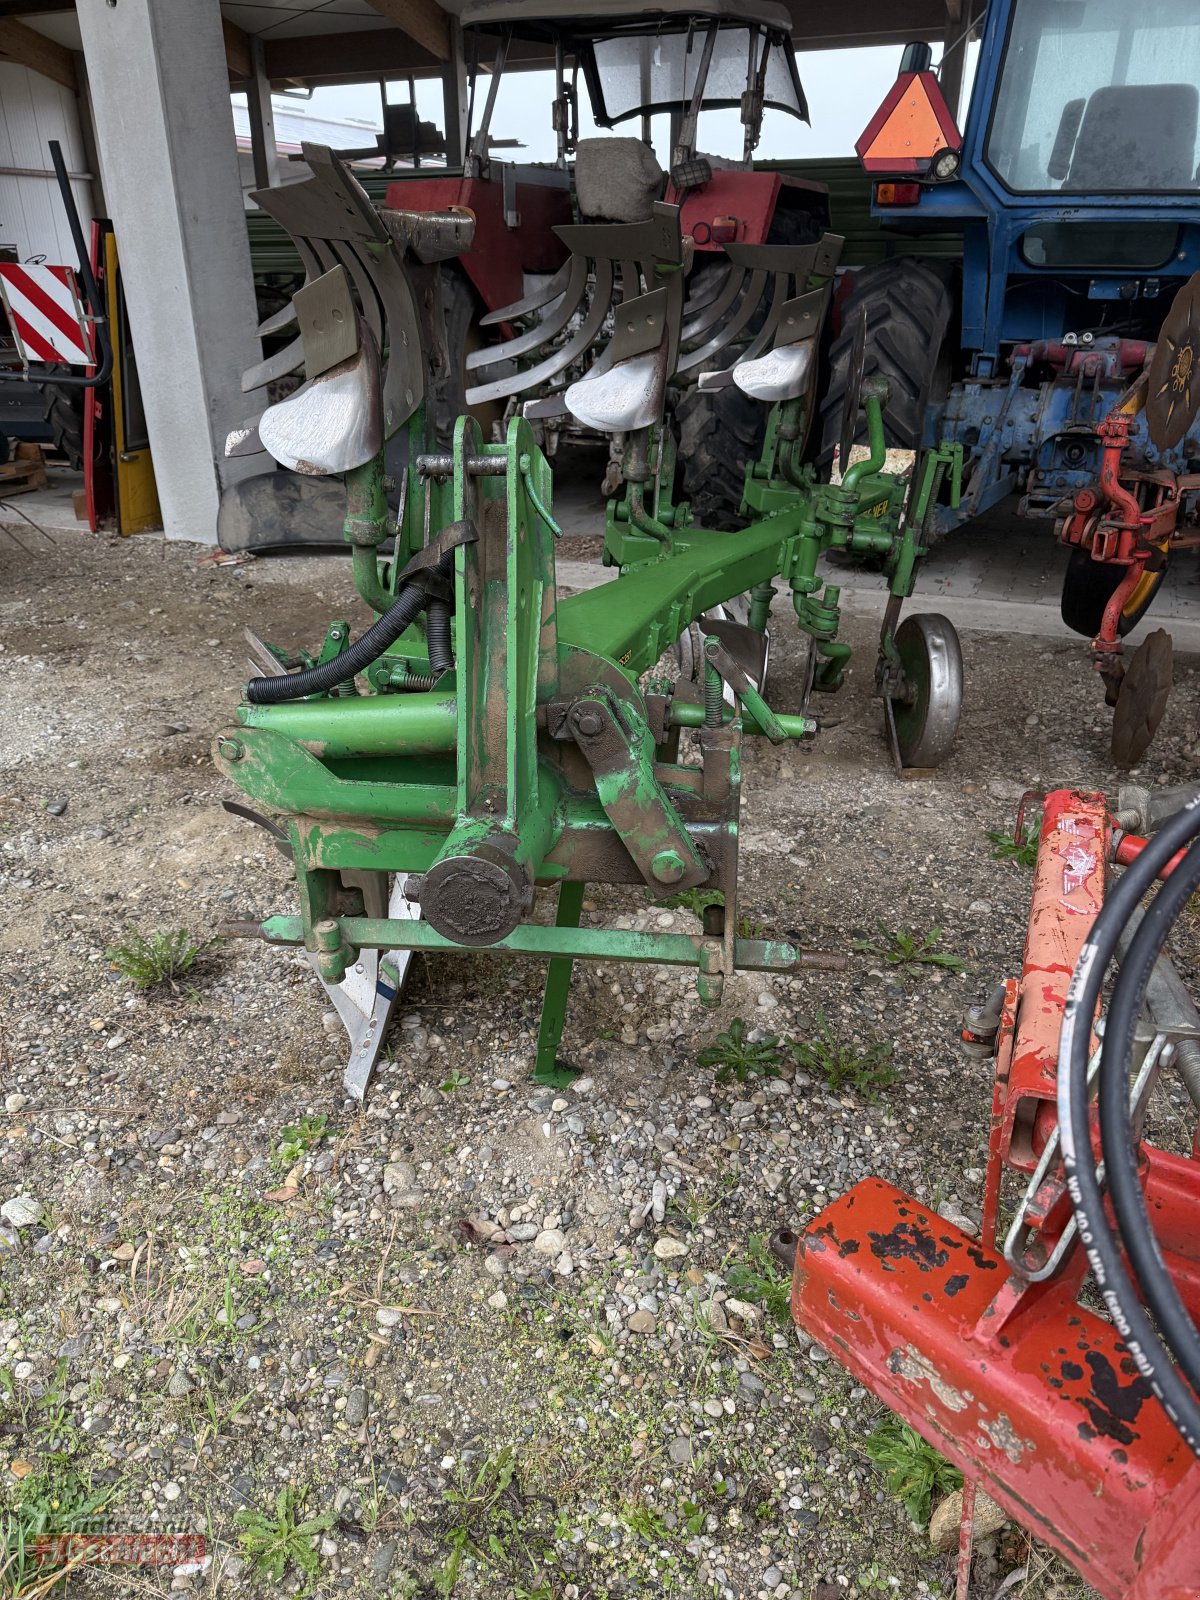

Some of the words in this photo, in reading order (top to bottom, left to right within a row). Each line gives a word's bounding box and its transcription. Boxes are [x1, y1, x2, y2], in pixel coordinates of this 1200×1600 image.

[1068, 1175, 1082, 1204] WP
[1075, 1209, 1093, 1244] 40.0
[1086, 1248, 1106, 1285] MPa
